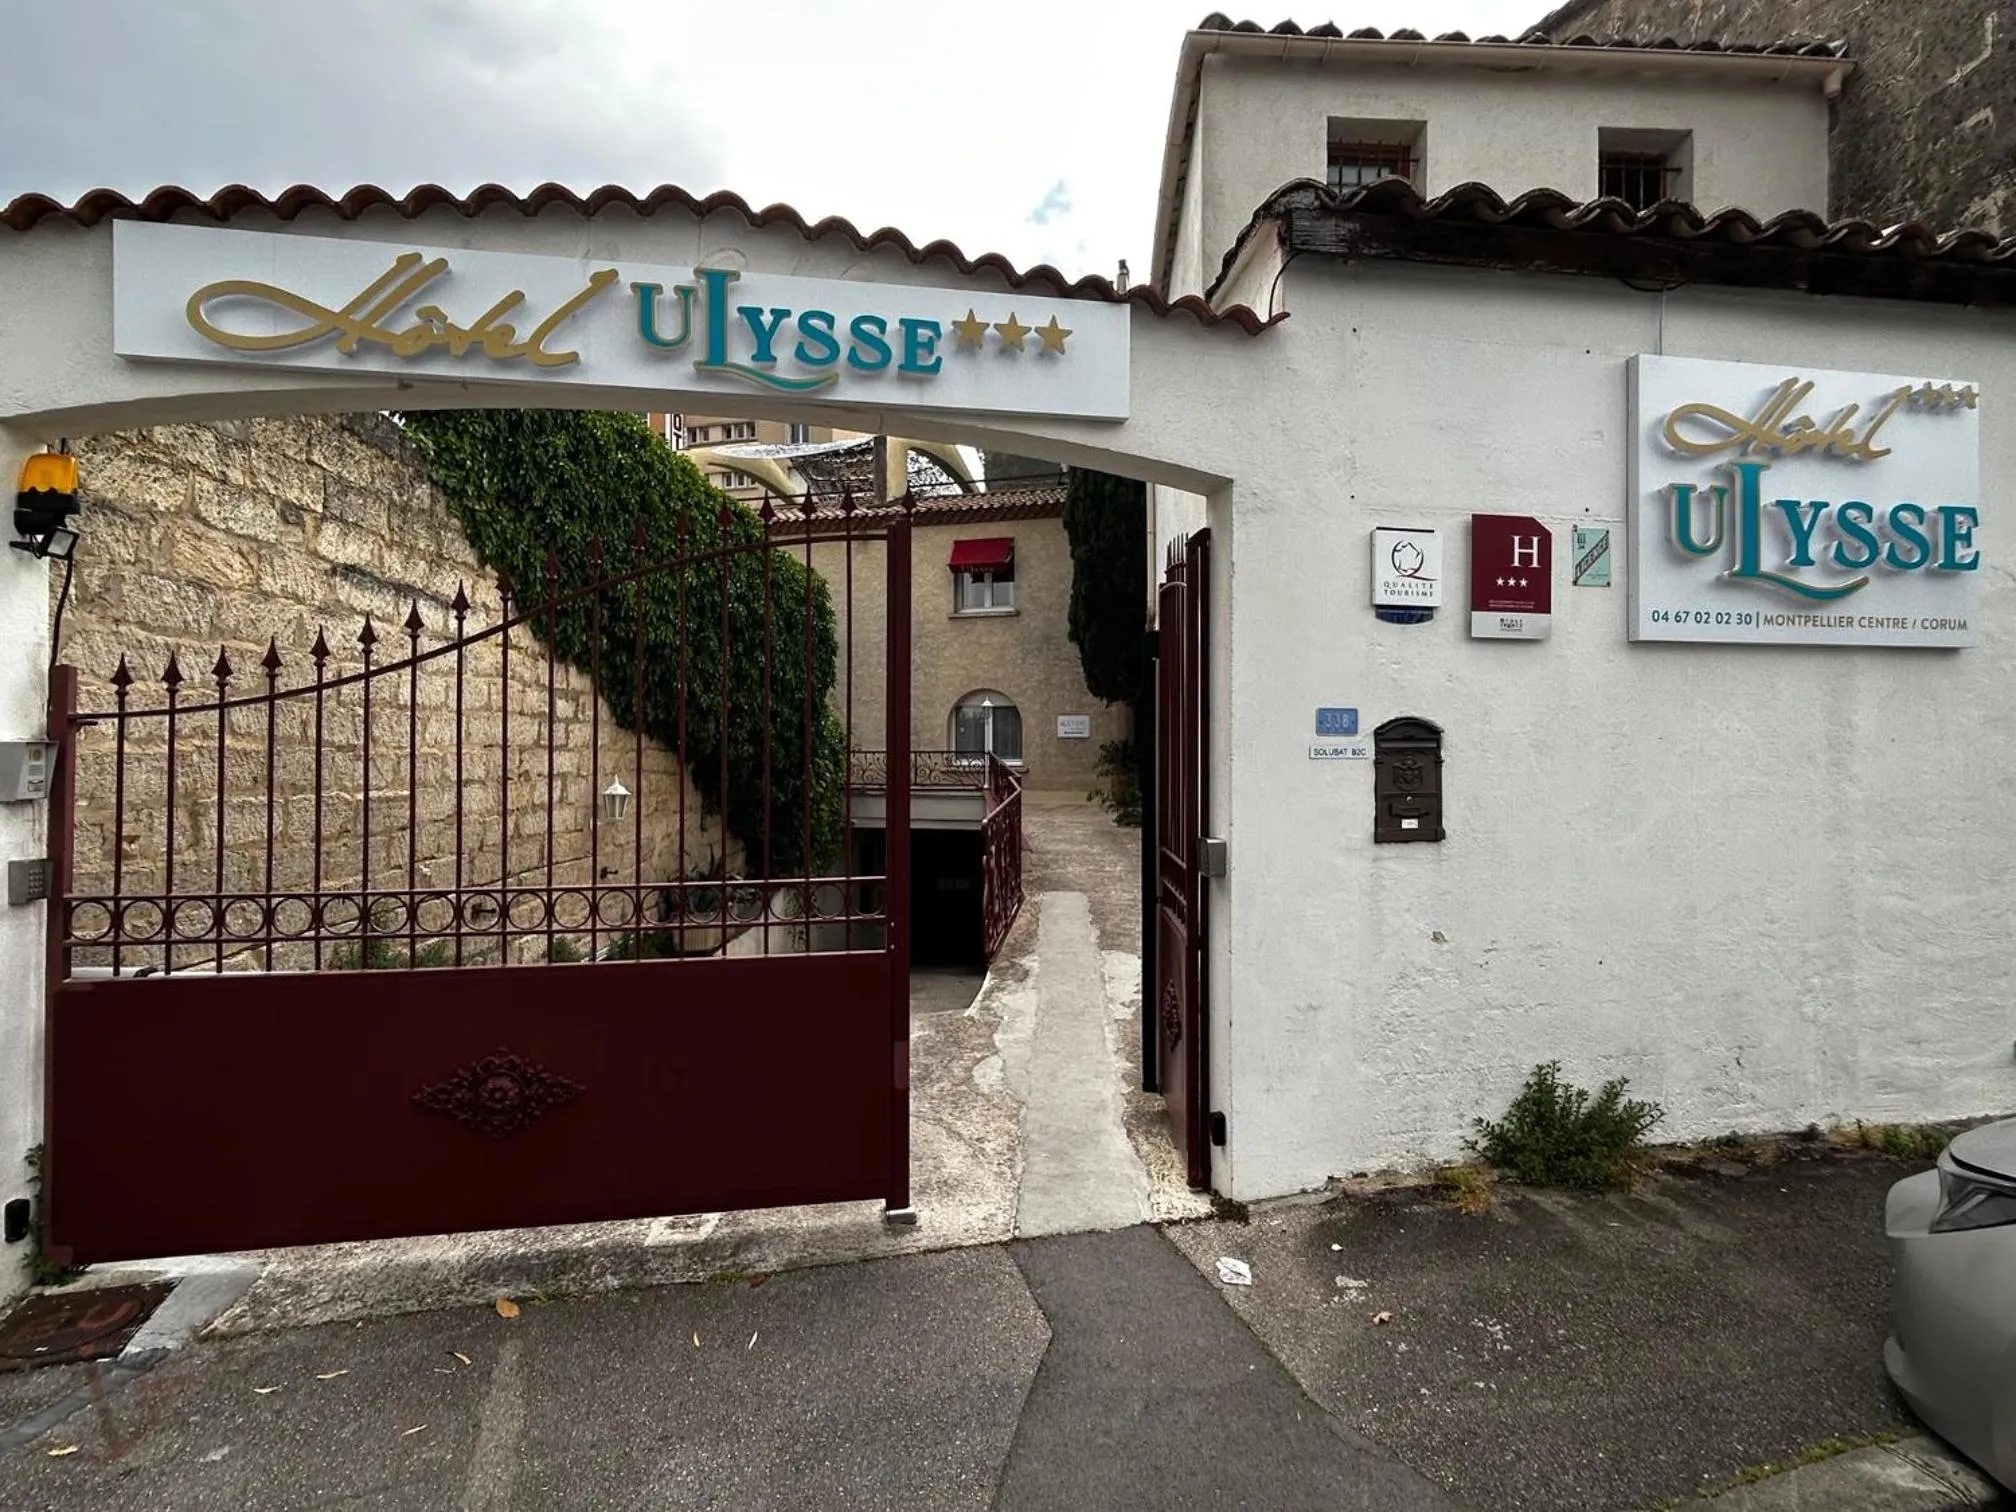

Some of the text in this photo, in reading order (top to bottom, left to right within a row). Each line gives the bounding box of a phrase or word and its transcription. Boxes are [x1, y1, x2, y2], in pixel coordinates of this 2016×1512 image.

[630, 267, 943, 392] ULYSSE
[1670, 458, 1981, 601] ULYSSE
[1511, 535, 1541, 568] H
[1384, 589, 1433, 597] TOURISME
[1651, 610, 1669, 623] 04
[1674, 610, 1690, 623] 67
[1694, 612, 1711, 624] 02
[1715, 612, 1731, 625] 02
[1736, 612, 1752, 626] 30
[1763, 614, 1854, 629] MONTPELLIER
[1858, 616, 1908, 629] CENTRE
[1921, 618, 1968, 631] CORUM
